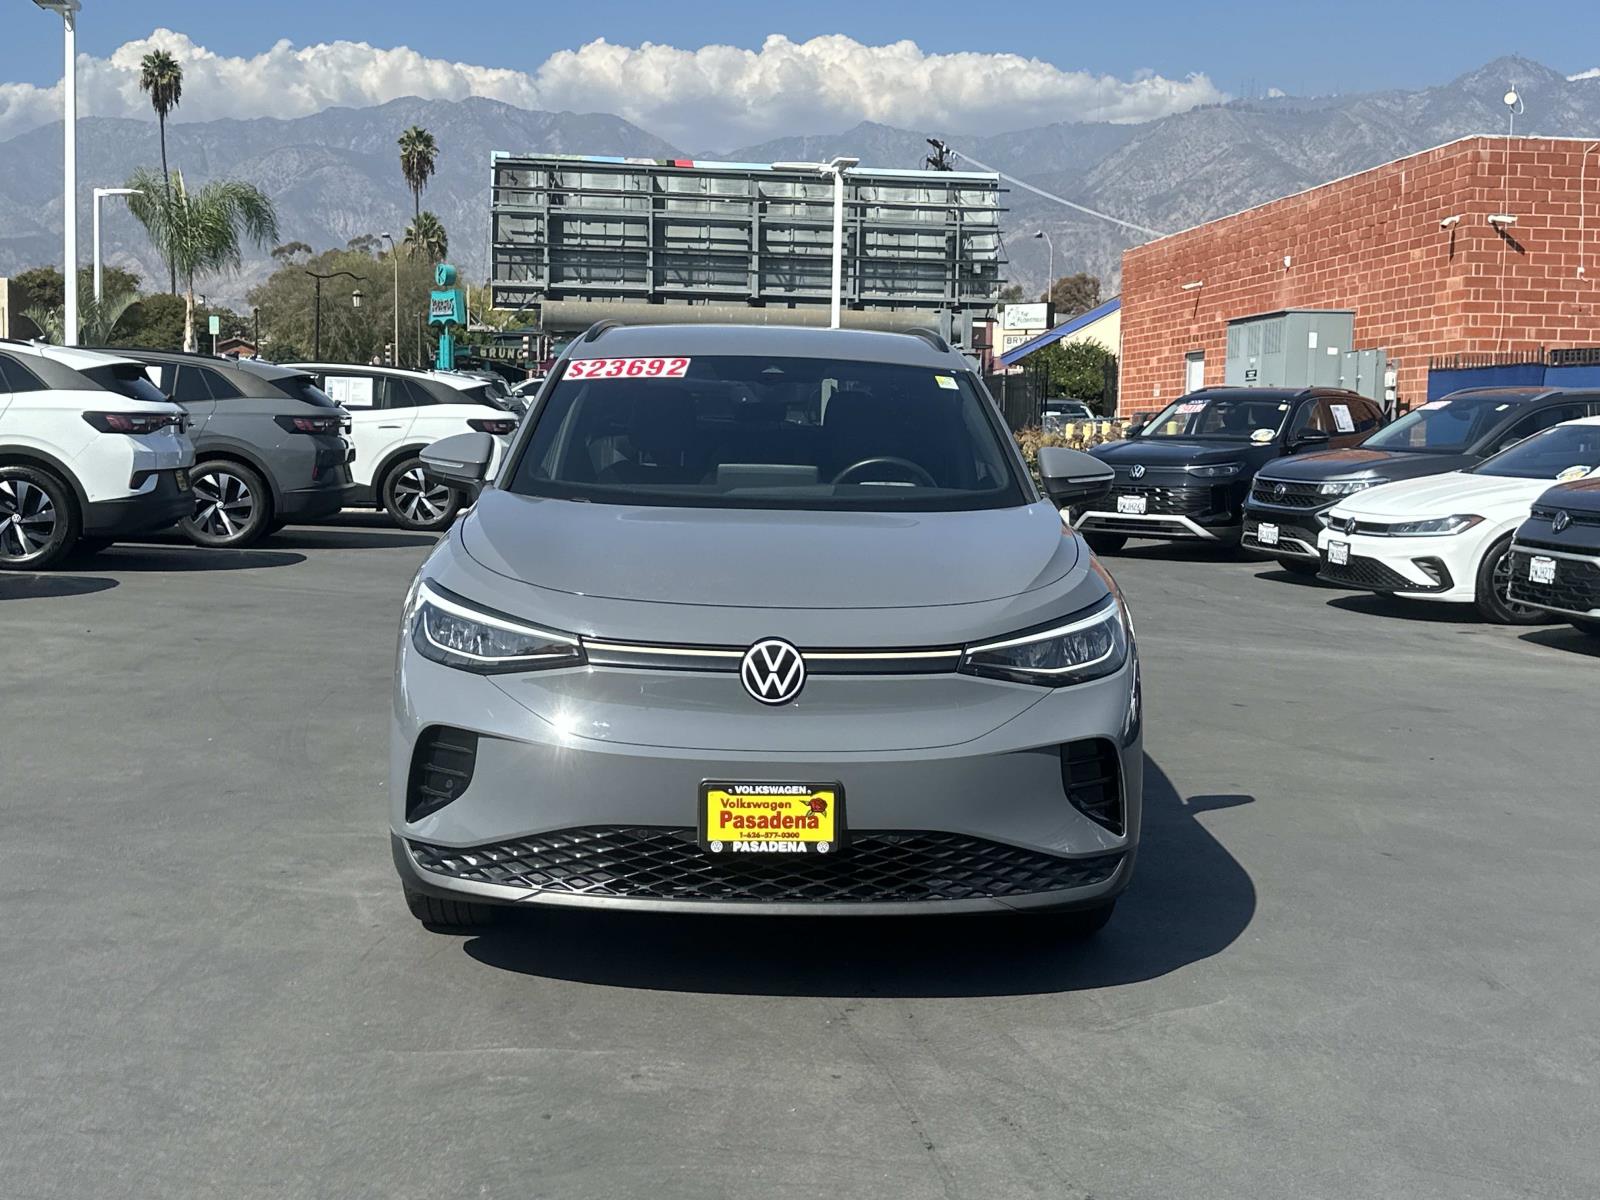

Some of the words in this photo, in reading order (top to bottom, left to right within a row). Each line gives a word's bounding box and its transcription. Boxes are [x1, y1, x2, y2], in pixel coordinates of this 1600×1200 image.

[568, 359, 688, 378] $23692
[734, 785, 807, 795] VOLKSWAGEN
[720, 798, 792, 811] Volkswagen
[719, 811, 820, 830] Pasadena
[732, 841, 808, 853] PASADENA
